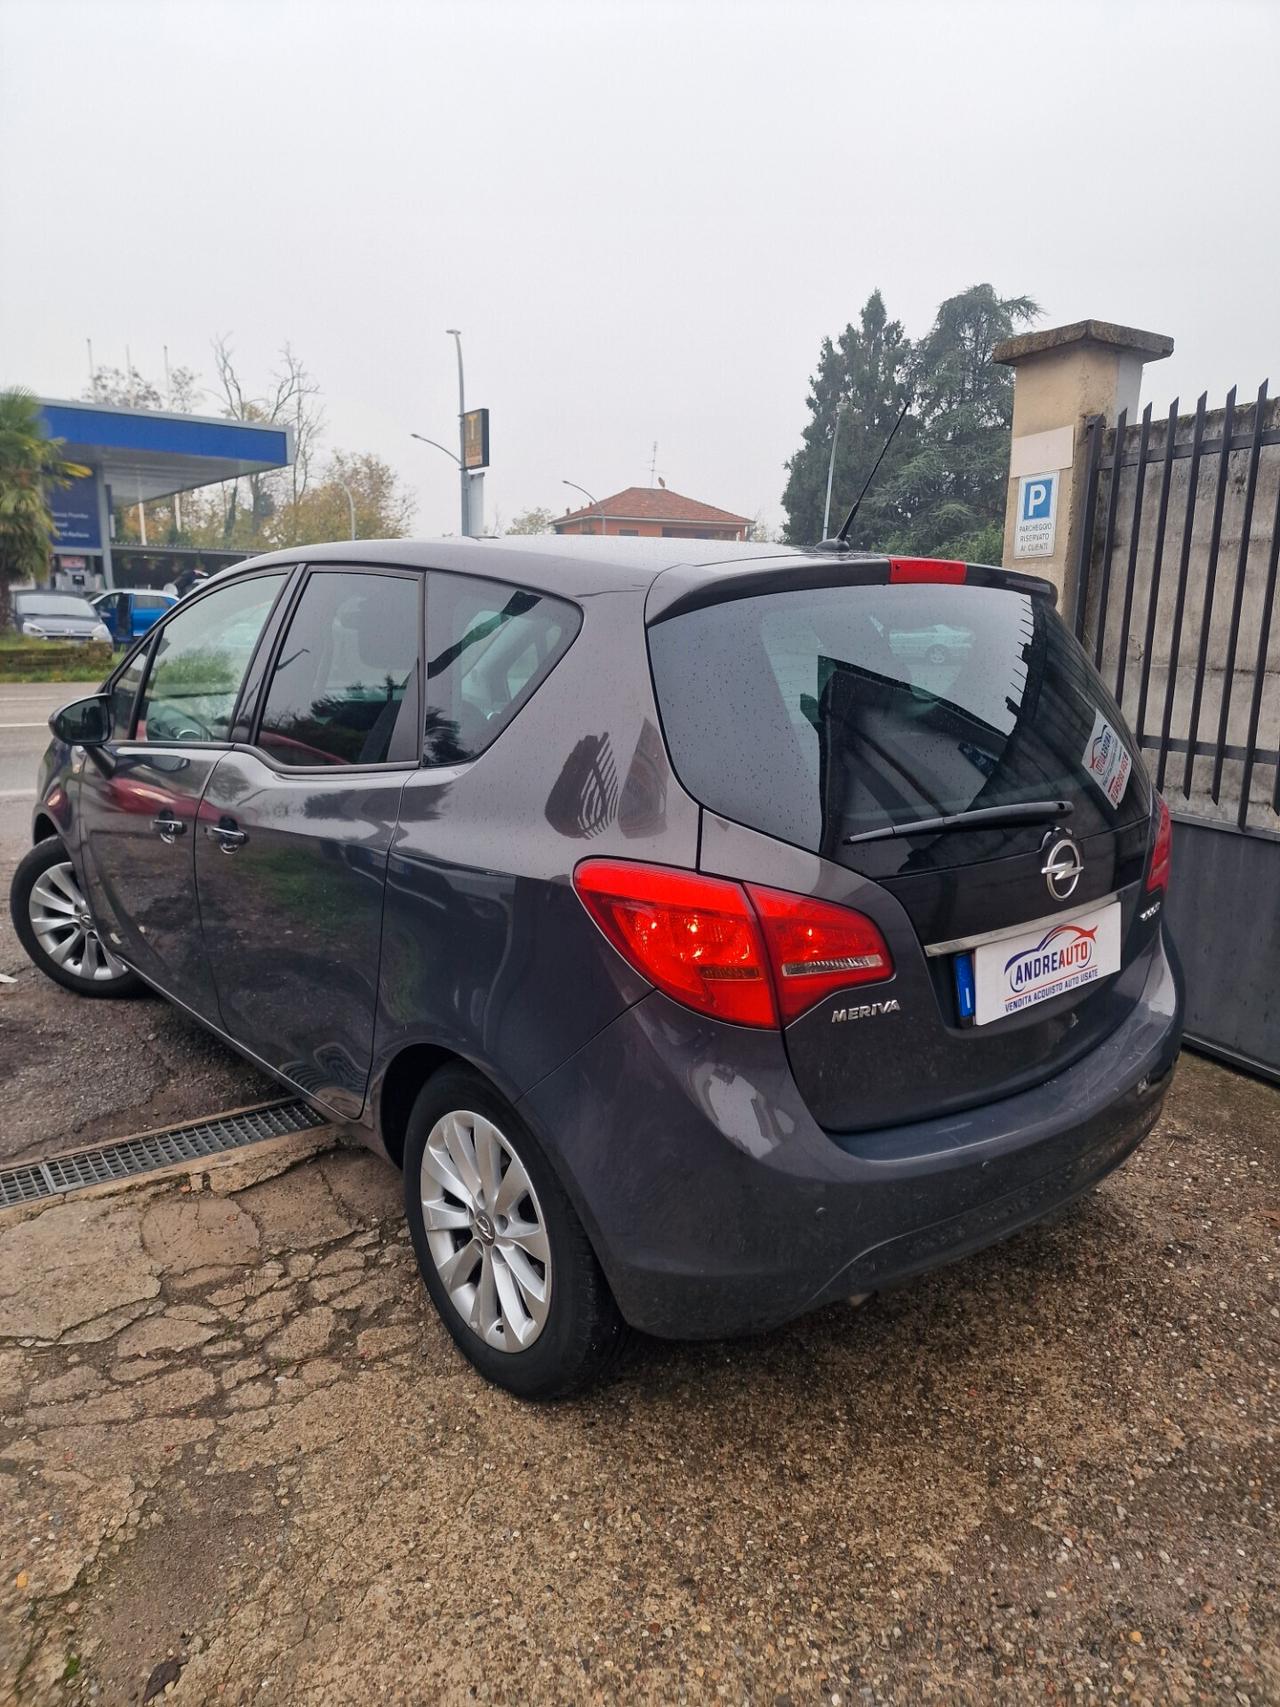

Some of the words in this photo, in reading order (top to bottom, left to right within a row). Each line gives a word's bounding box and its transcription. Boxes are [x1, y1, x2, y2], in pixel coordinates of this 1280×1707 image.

[1028, 484, 1047, 517] P
[1019, 522, 1052, 532] PARCHEGGIO
[1020, 532, 1050, 543] RISERVATO
[1020, 544, 1026, 552] AI
[1027, 543, 1049, 552] CLIENTI
[1015, 941, 1088, 986] ANDREAUTO
[1005, 995, 1032, 1013] VENDITA
[1033, 985, 1063, 1003] ACQUISTO
[1064, 978, 1080, 991] AUTO
[1080, 968, 1099, 984] USATE
[831, 999, 901, 1023] MERIVA
